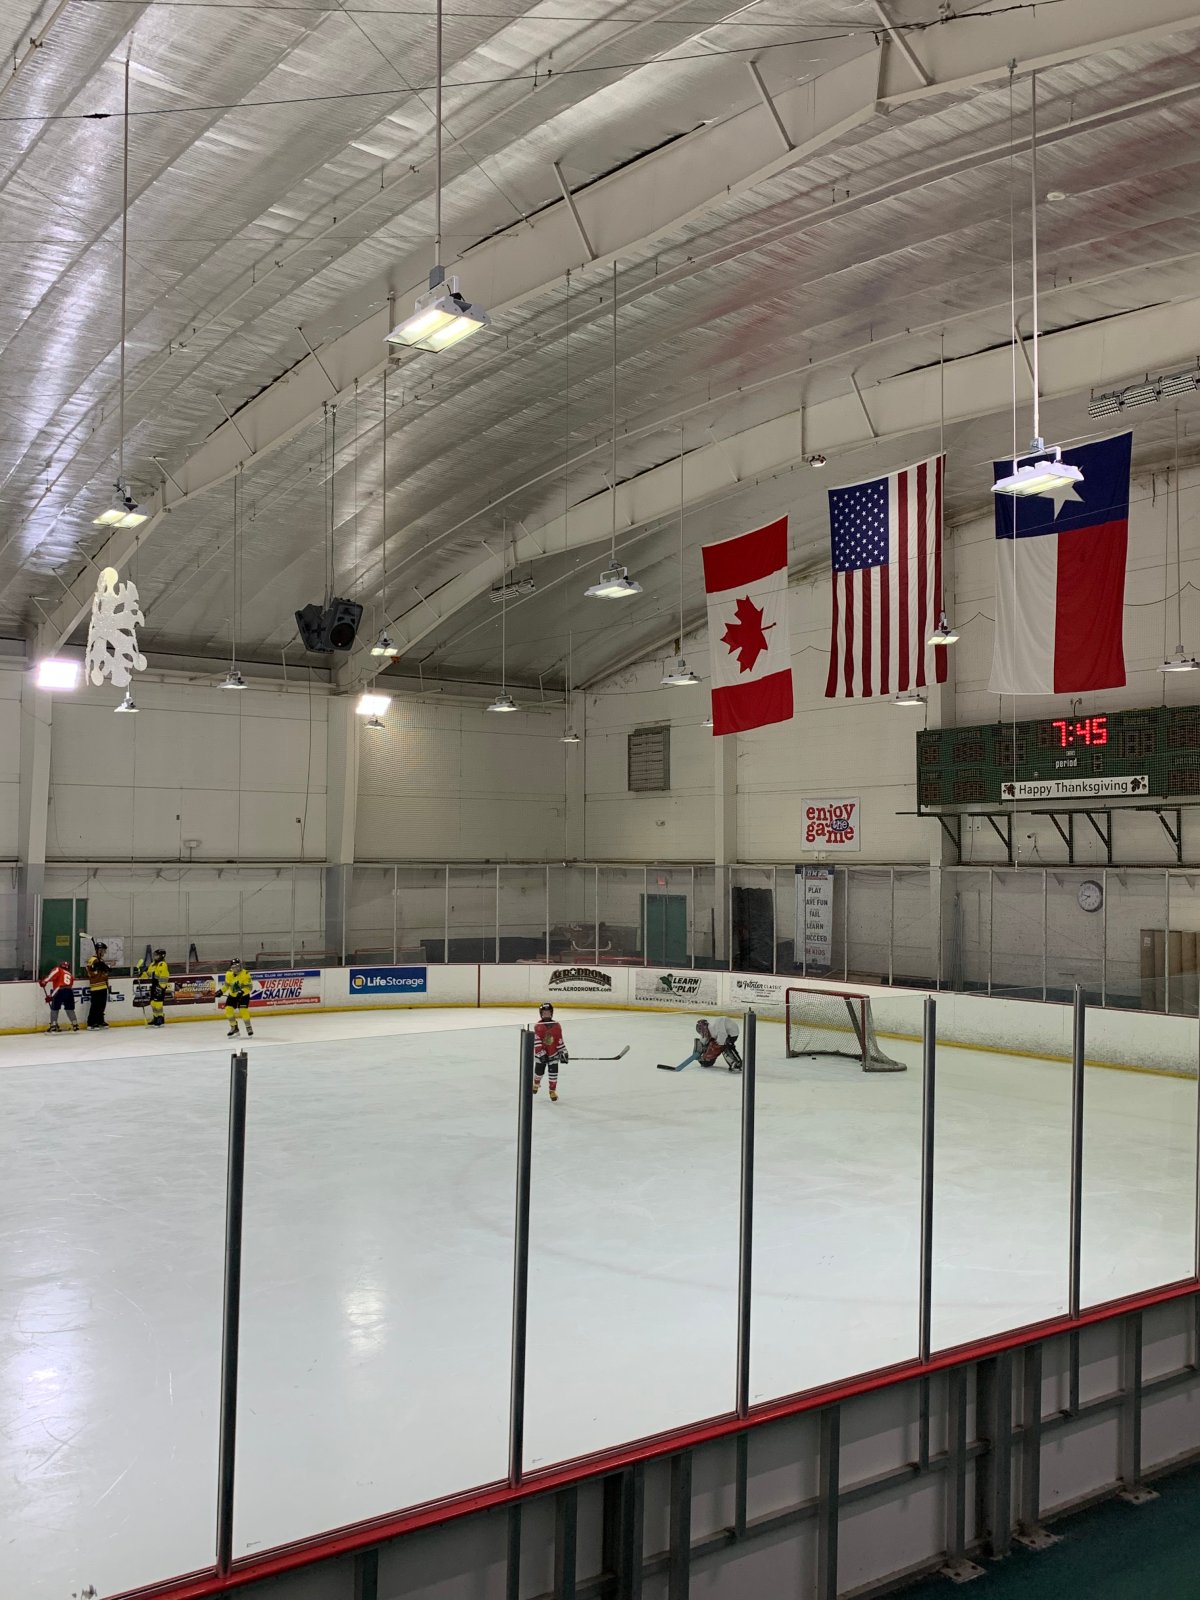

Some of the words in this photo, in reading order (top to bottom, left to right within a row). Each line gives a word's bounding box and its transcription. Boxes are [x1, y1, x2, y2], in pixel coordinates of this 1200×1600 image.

[1051, 717, 1107, 747] 7:45
[1055, 757, 1078, 769] period
[1019, 783, 1052, 797] Happy
[1055, 779, 1128, 794] Thanksgiving
[805, 803, 856, 828] enjoy
[831, 820, 848, 830] the
[805, 821, 855, 844] game
[807, 886, 822, 894] PLAY
[806, 922, 824, 930] LEARN
[805, 934, 828, 942] UCCEED
[63, 973, 72, 985] 6
[277, 978, 305, 988] FIGURE
[673, 977, 699, 985] LEARN
[263, 987, 302, 999] SKATING
[677, 985, 698, 994] PLAY
